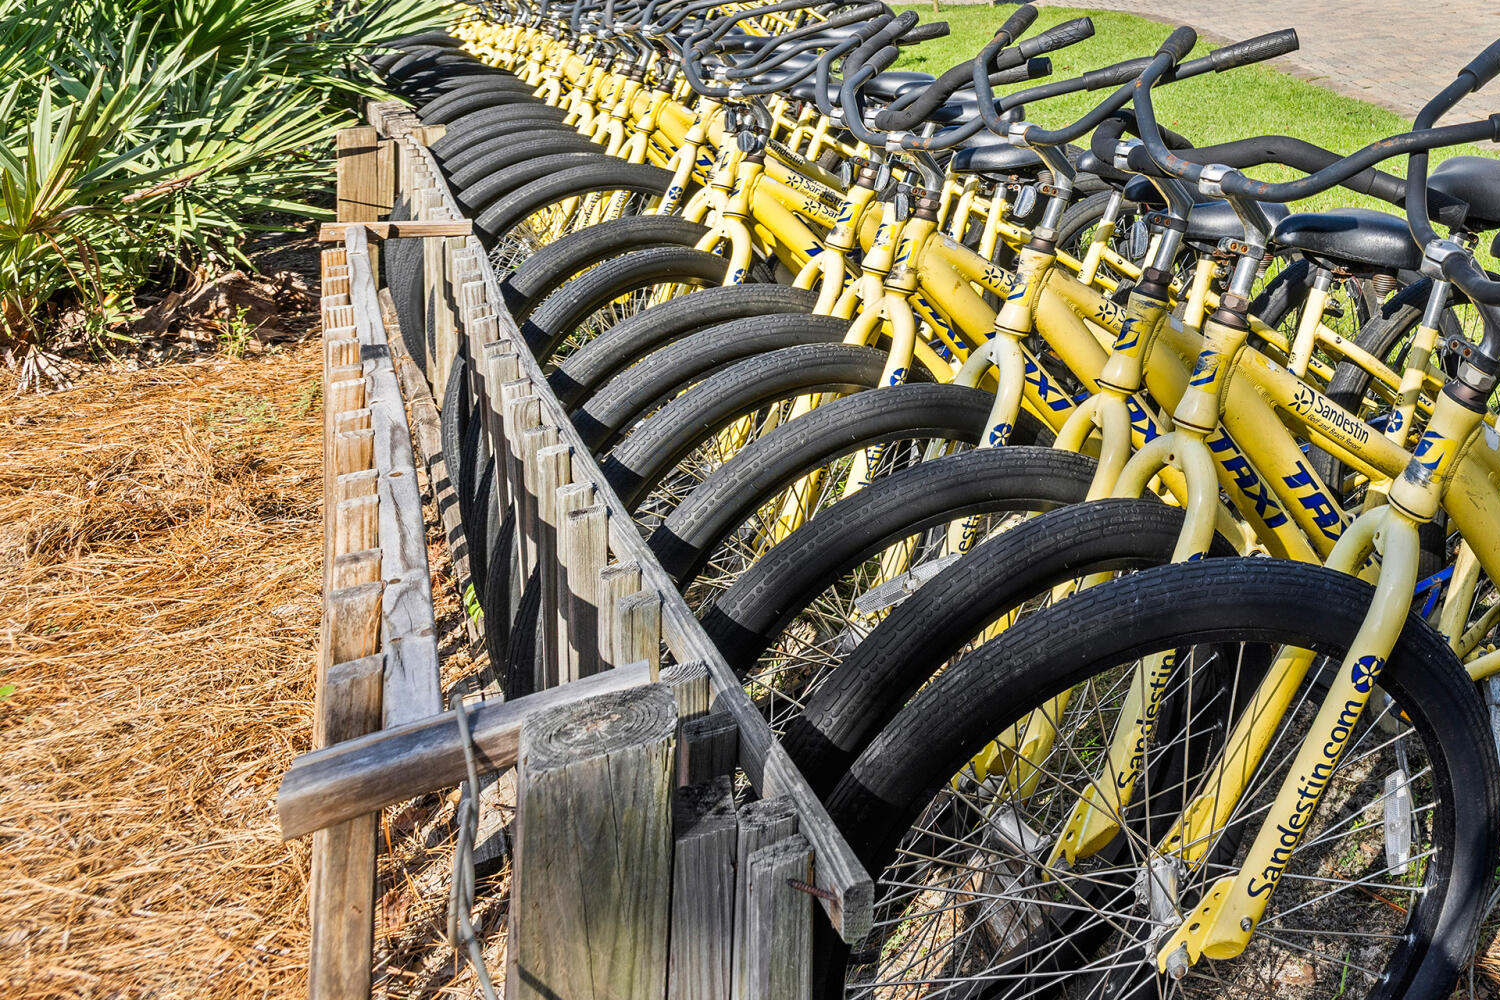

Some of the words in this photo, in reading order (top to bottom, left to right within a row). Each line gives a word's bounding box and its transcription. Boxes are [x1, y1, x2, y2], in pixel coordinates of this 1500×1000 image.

[1307, 414, 1319, 426] Golf
[1319, 421, 1329, 432] and
[1329, 427, 1345, 441] Beach
[1315, 395, 1369, 444] Sandestin
[1206, 427, 1289, 529] TAXI
[1117, 653, 1176, 789] Sandestin
[1247, 699, 1364, 901] Sandestin.com
